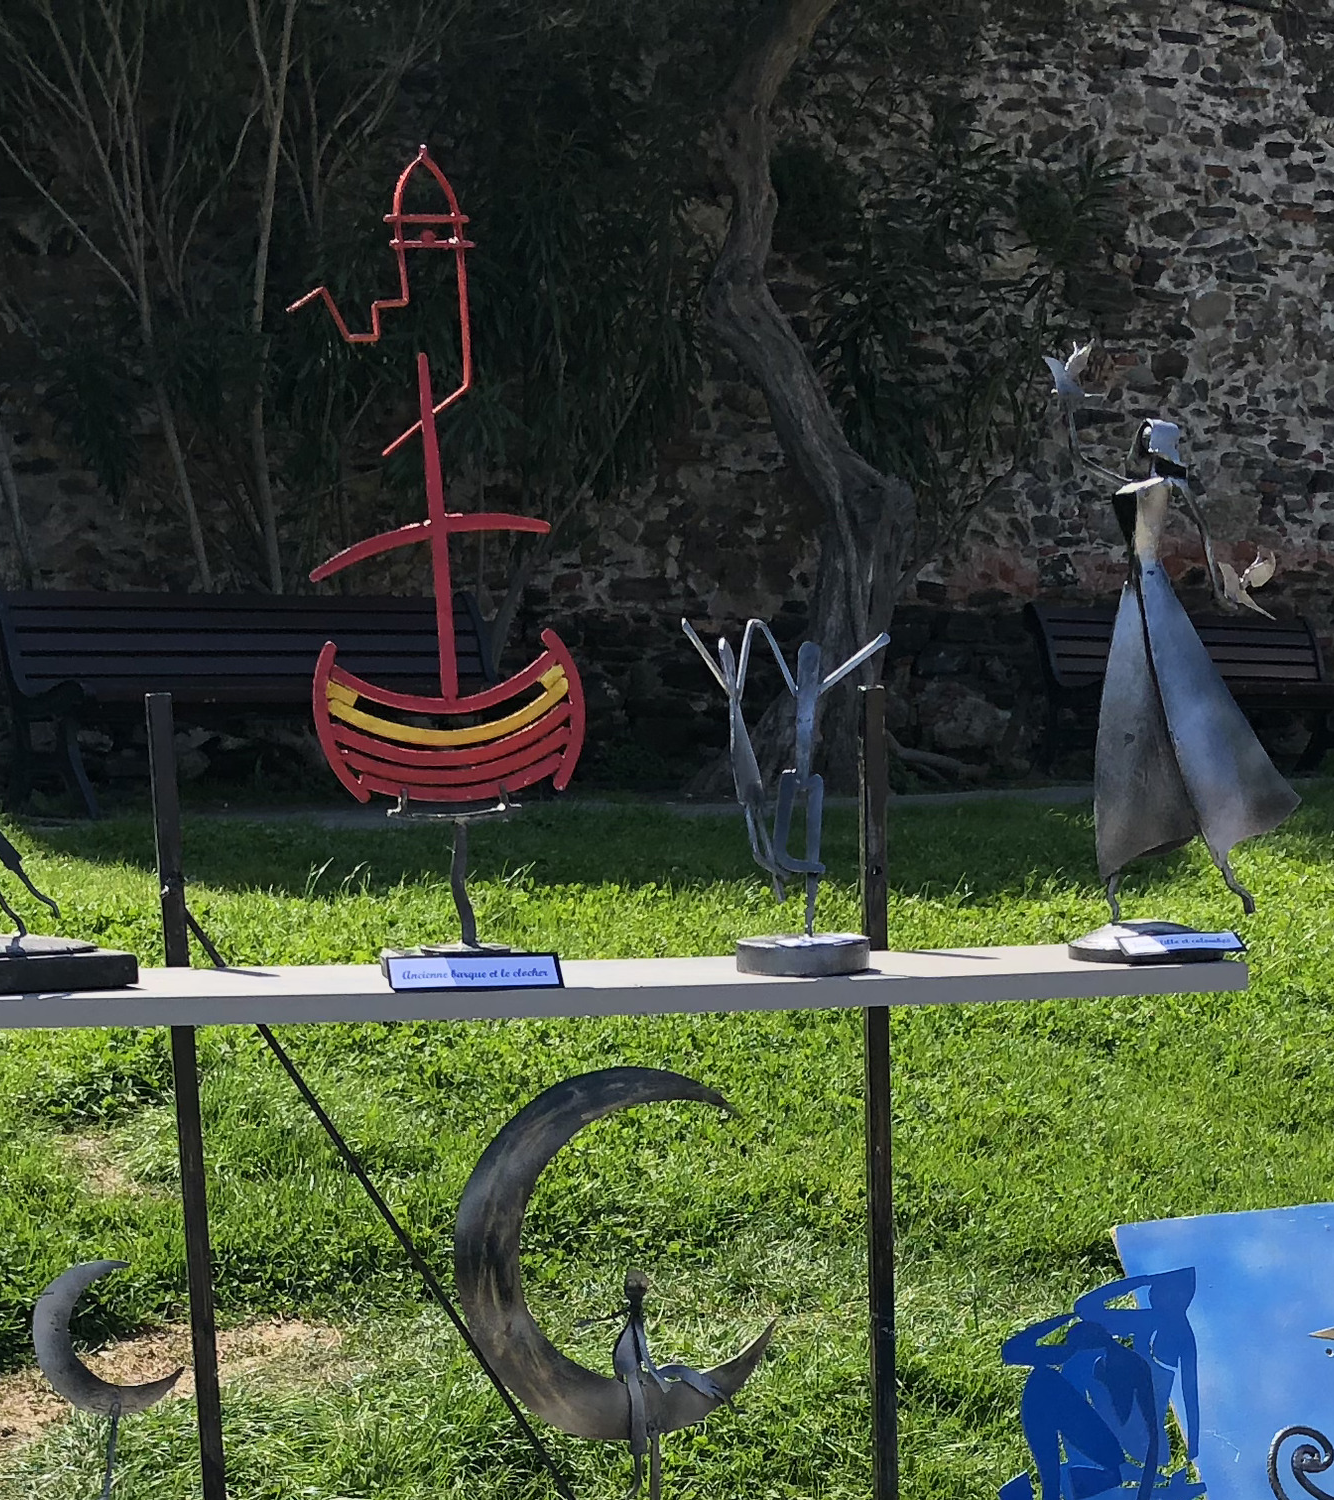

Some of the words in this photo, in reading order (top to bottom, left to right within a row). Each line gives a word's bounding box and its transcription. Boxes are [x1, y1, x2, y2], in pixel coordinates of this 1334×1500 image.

[402, 969, 448, 980] Ancienne
[451, 969, 487, 981] barque
[489, 970, 499, 978] et
[501, 968, 510, 978] le
[513, 967, 548, 978] clocher
